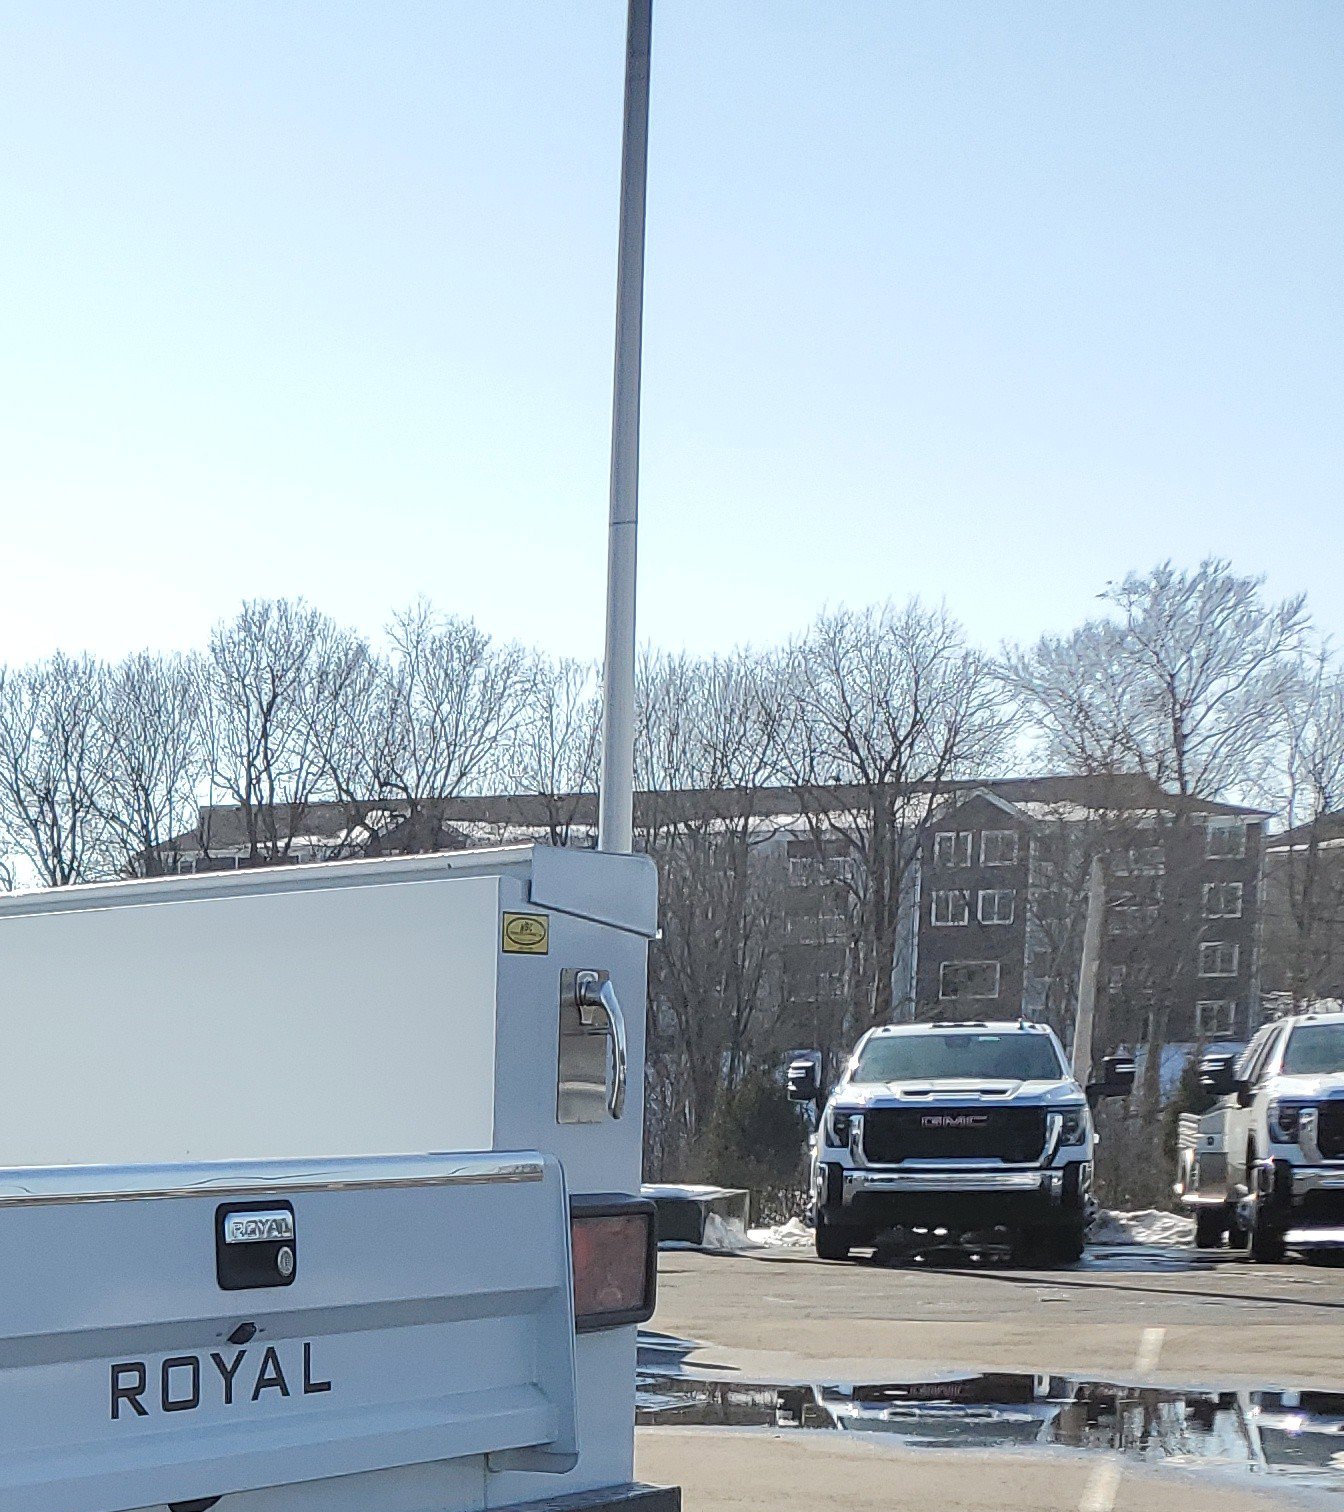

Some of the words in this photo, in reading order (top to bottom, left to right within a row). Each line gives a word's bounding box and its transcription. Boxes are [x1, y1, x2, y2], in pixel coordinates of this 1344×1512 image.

[921, 1115, 988, 1129] GMC
[232, 1217, 292, 1239] ROYAL
[109, 1341, 332, 1420] ROYAL
